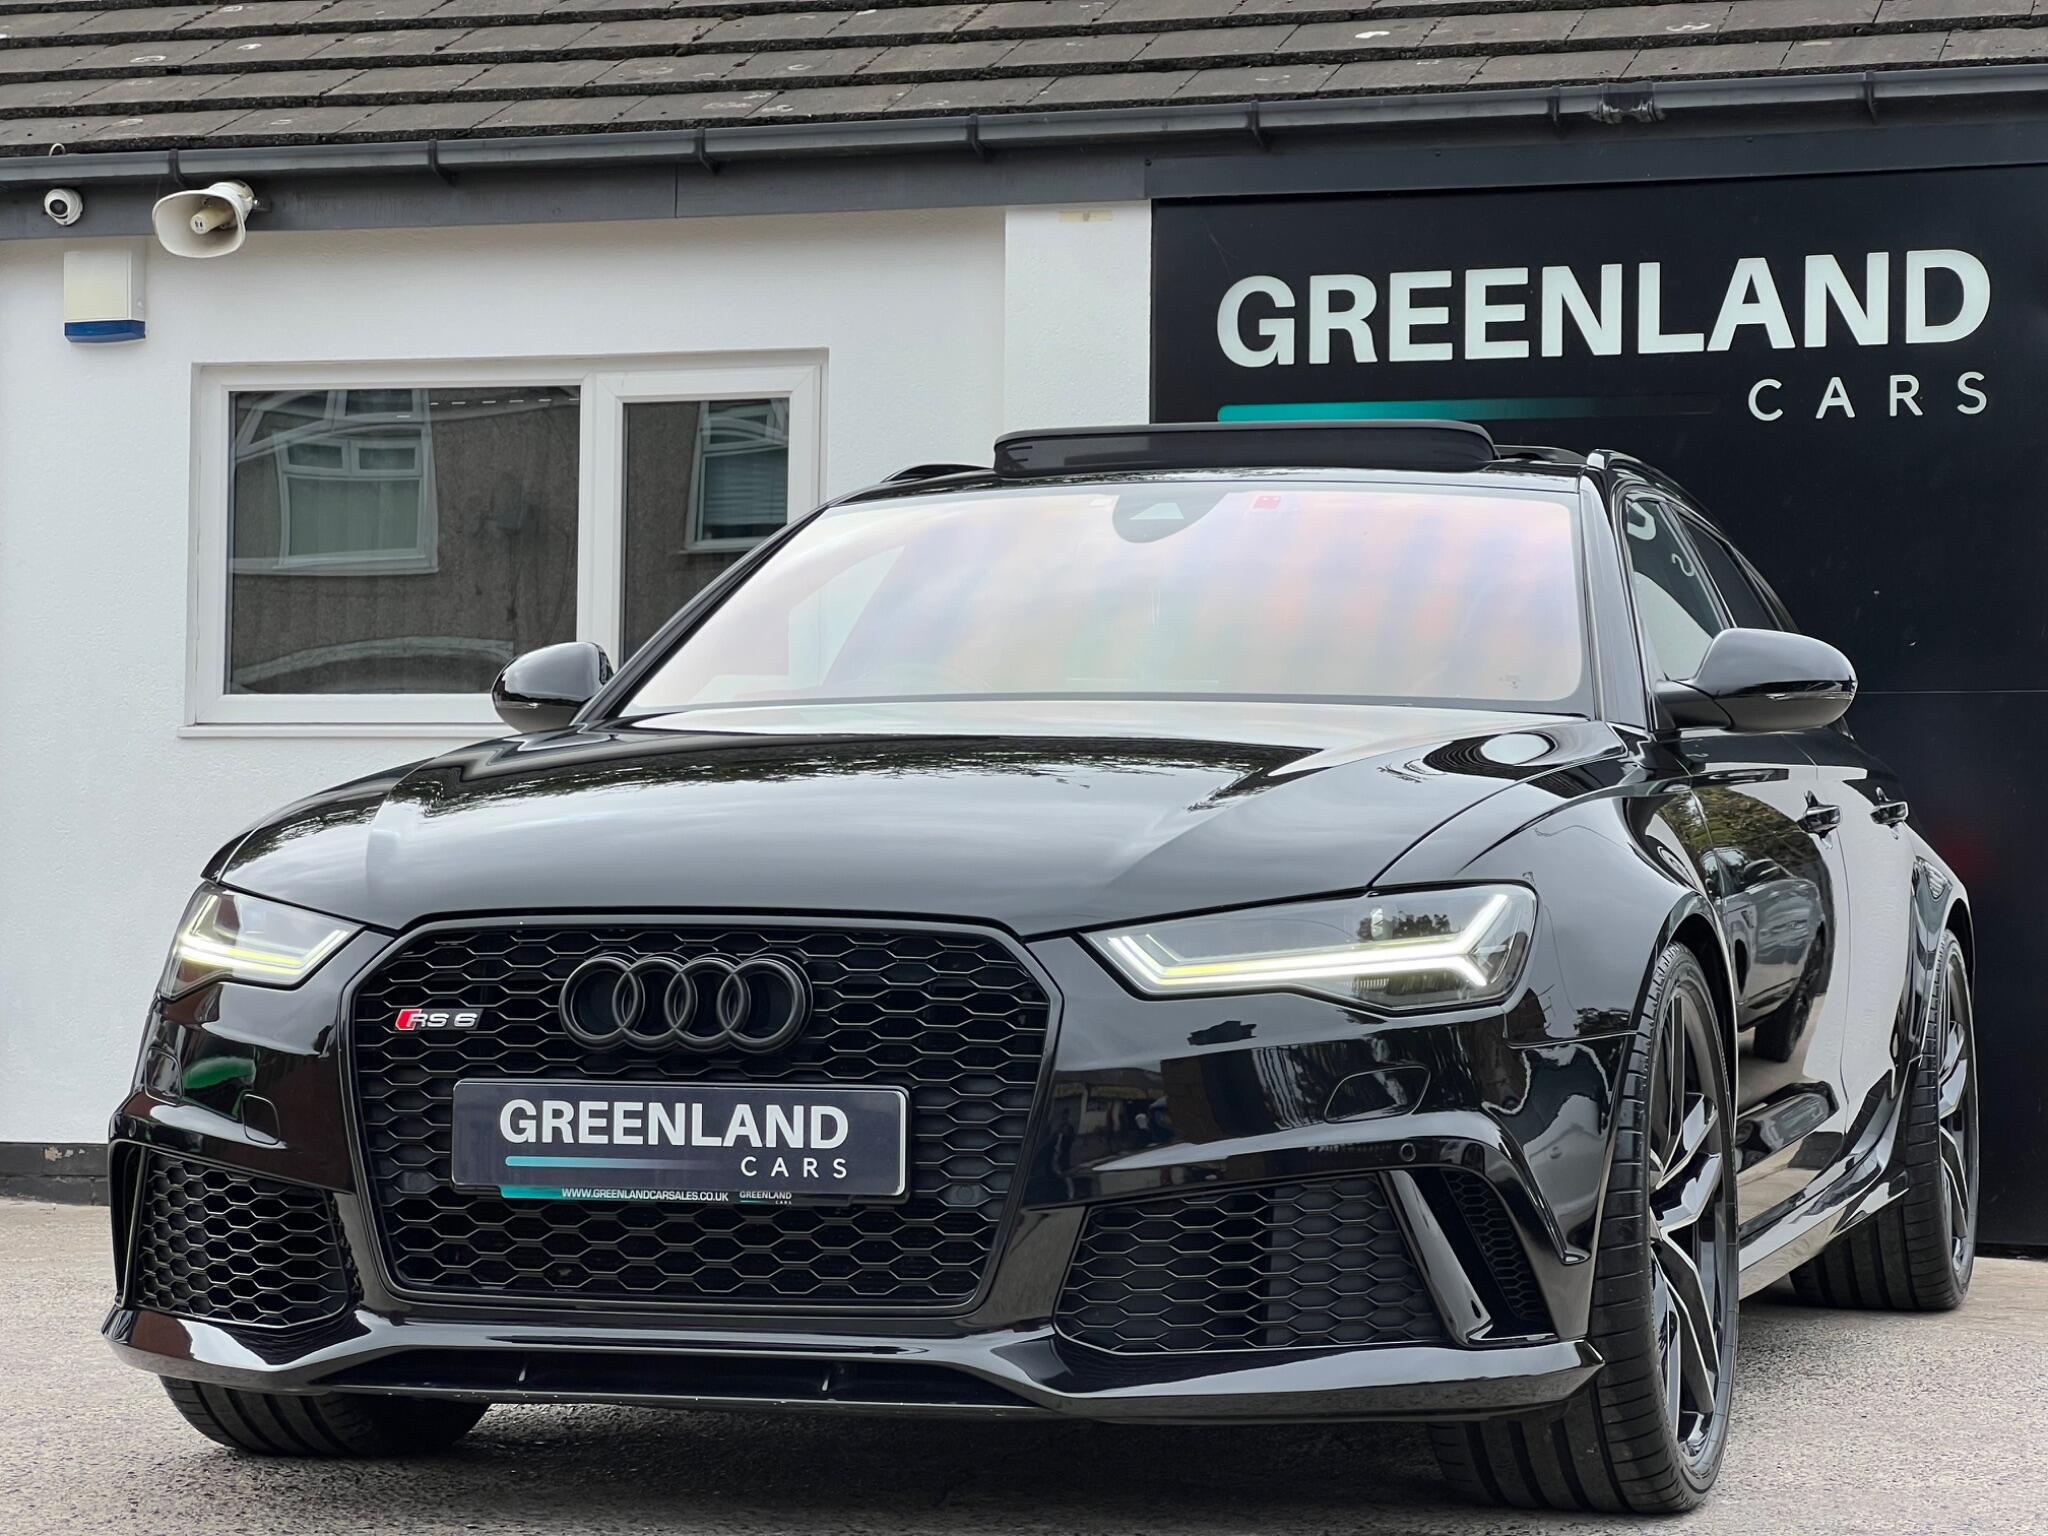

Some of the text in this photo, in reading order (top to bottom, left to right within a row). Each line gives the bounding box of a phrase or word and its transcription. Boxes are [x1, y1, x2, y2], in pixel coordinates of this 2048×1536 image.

[1217, 249, 1991, 368] GREENLAND
[1748, 371, 1987, 421] CARS
[499, 1099, 849, 1149] GREENLAND
[740, 1156, 848, 1179] CARS
[561, 1187, 729, 1202] WWW.GREENLANDCARSALES.CO.UK
[739, 1190, 793, 1200] GREENLAND
